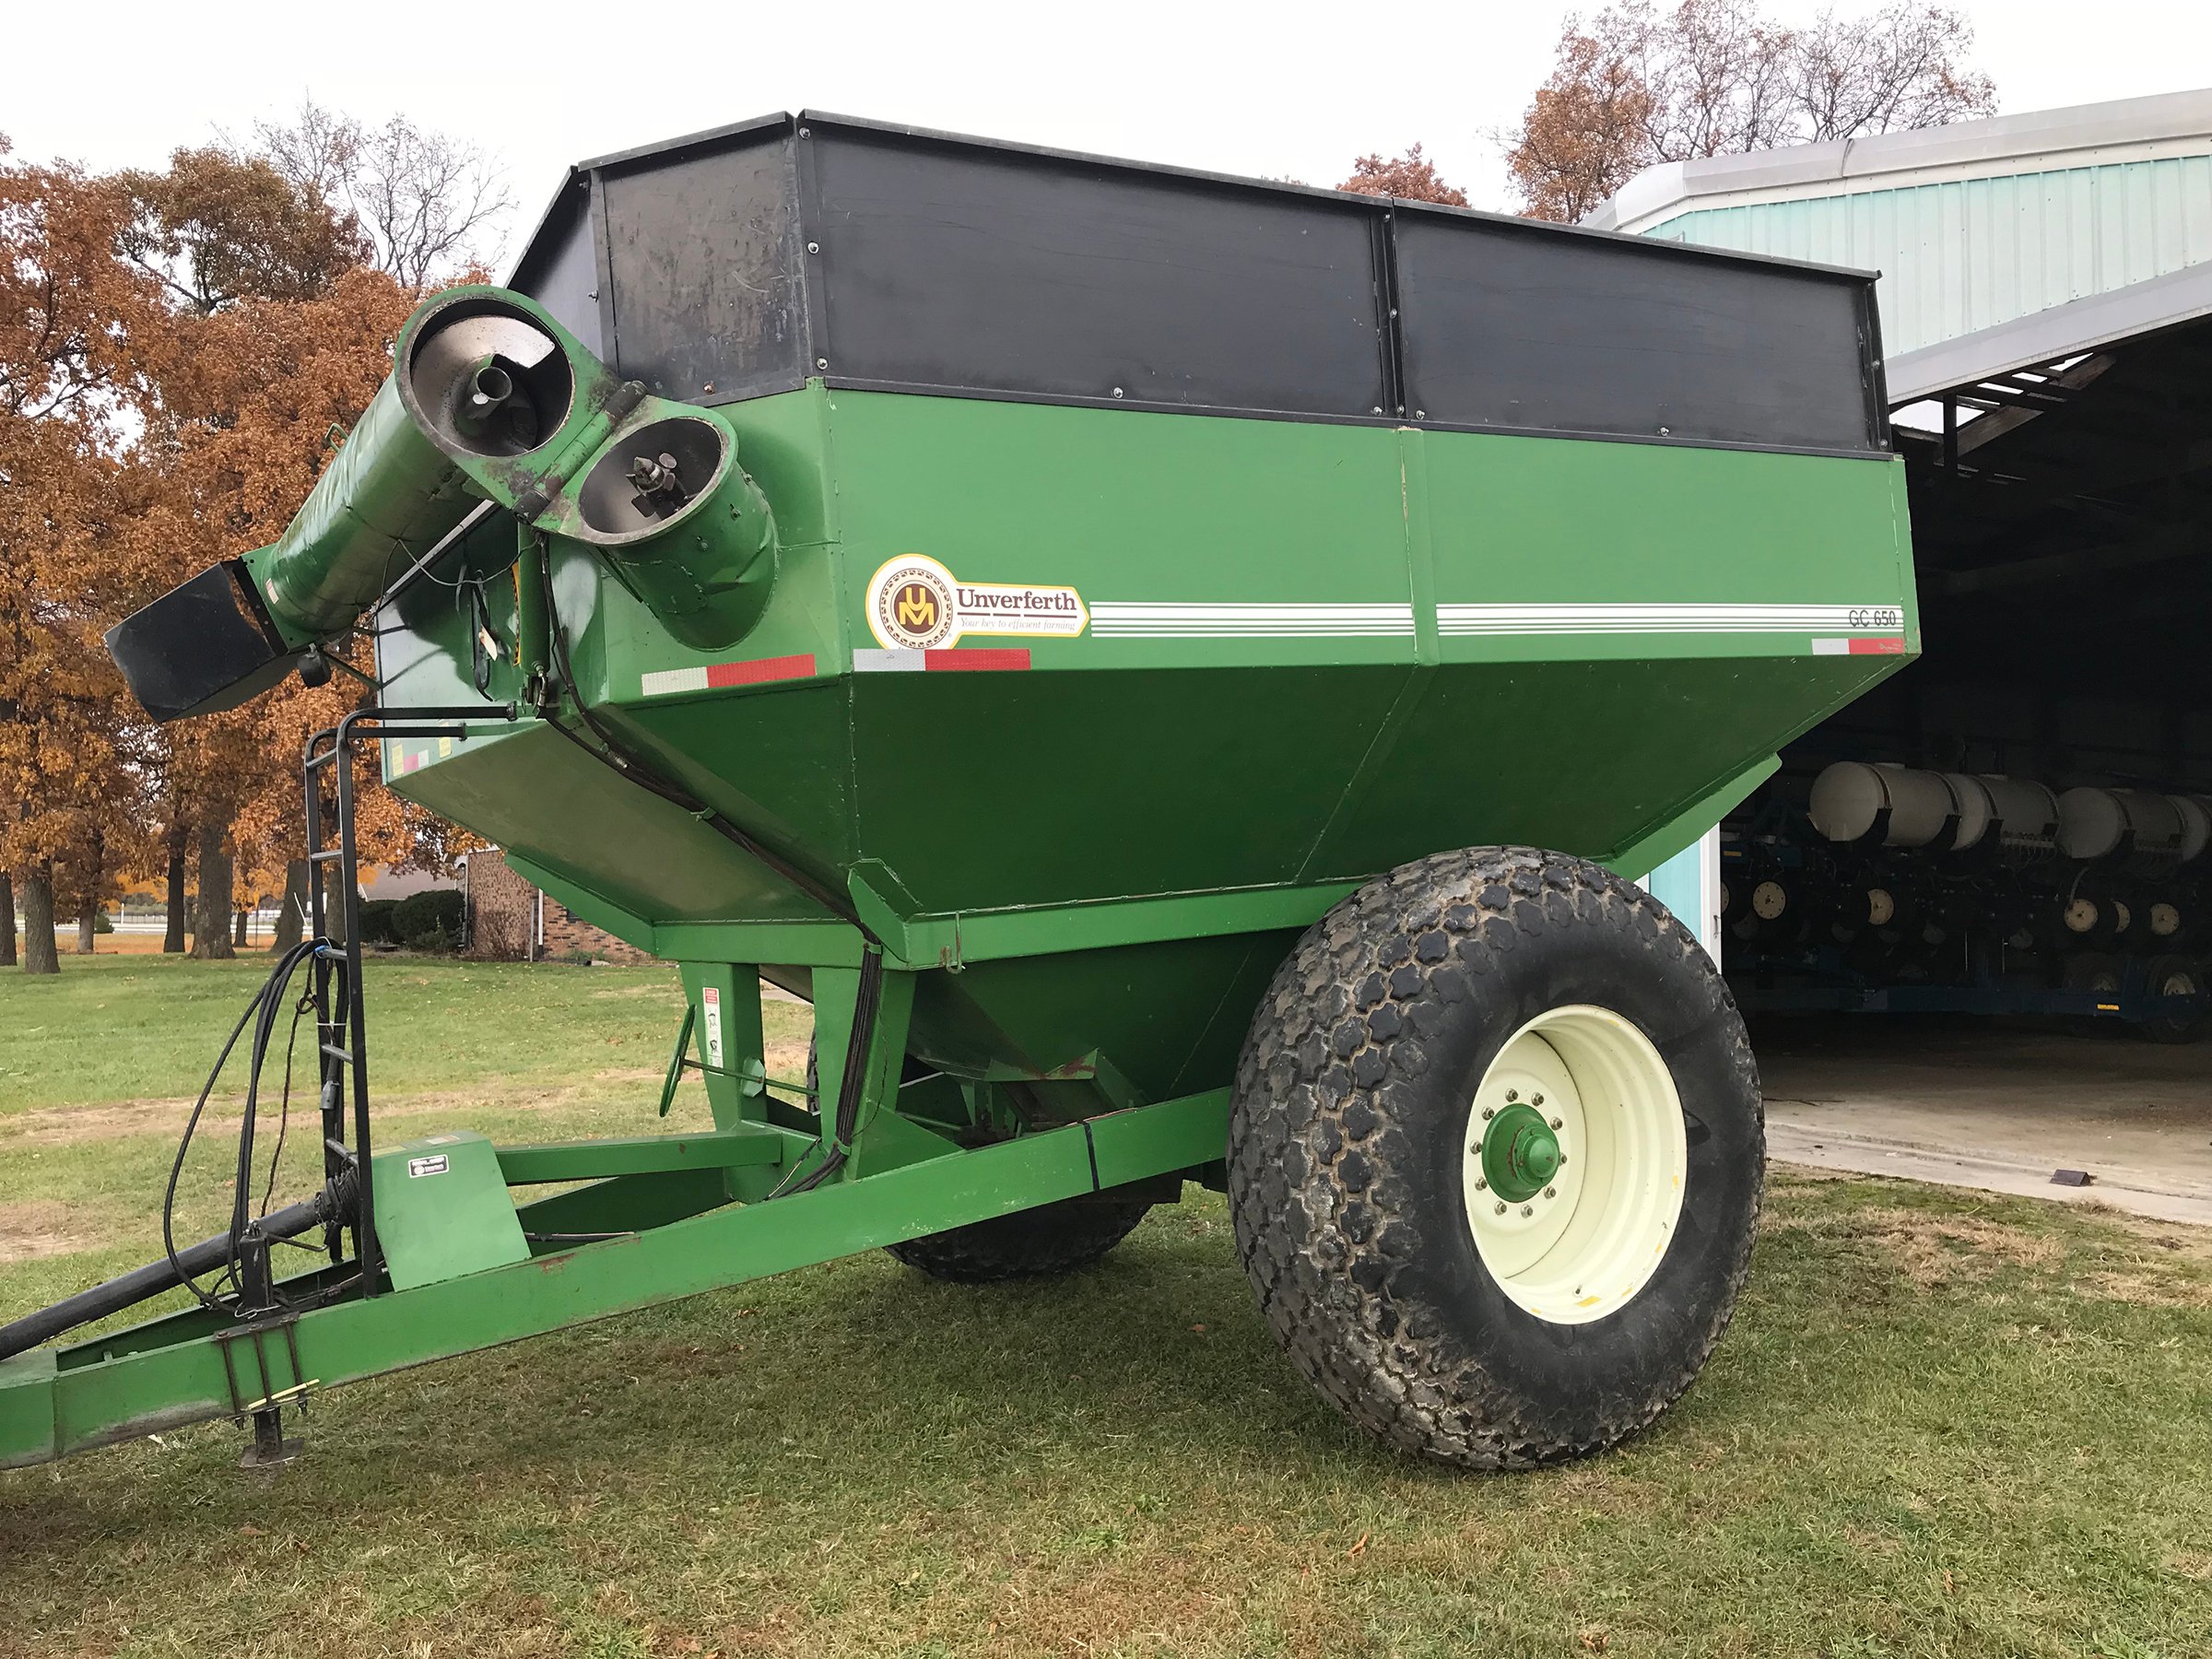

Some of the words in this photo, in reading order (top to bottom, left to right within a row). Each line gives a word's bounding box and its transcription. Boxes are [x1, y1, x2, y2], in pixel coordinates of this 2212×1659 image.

[956, 588, 1077, 610] Unverferth
[960, 617, 979, 628] Your
[981, 618, 997, 629] key
[998, 618, 1006, 628] to
[1008, 619, 1041, 630] efficient
[1043, 619, 1076, 631] farming
[1849, 609, 1870, 628] GC
[1874, 610, 1896, 626] 650
